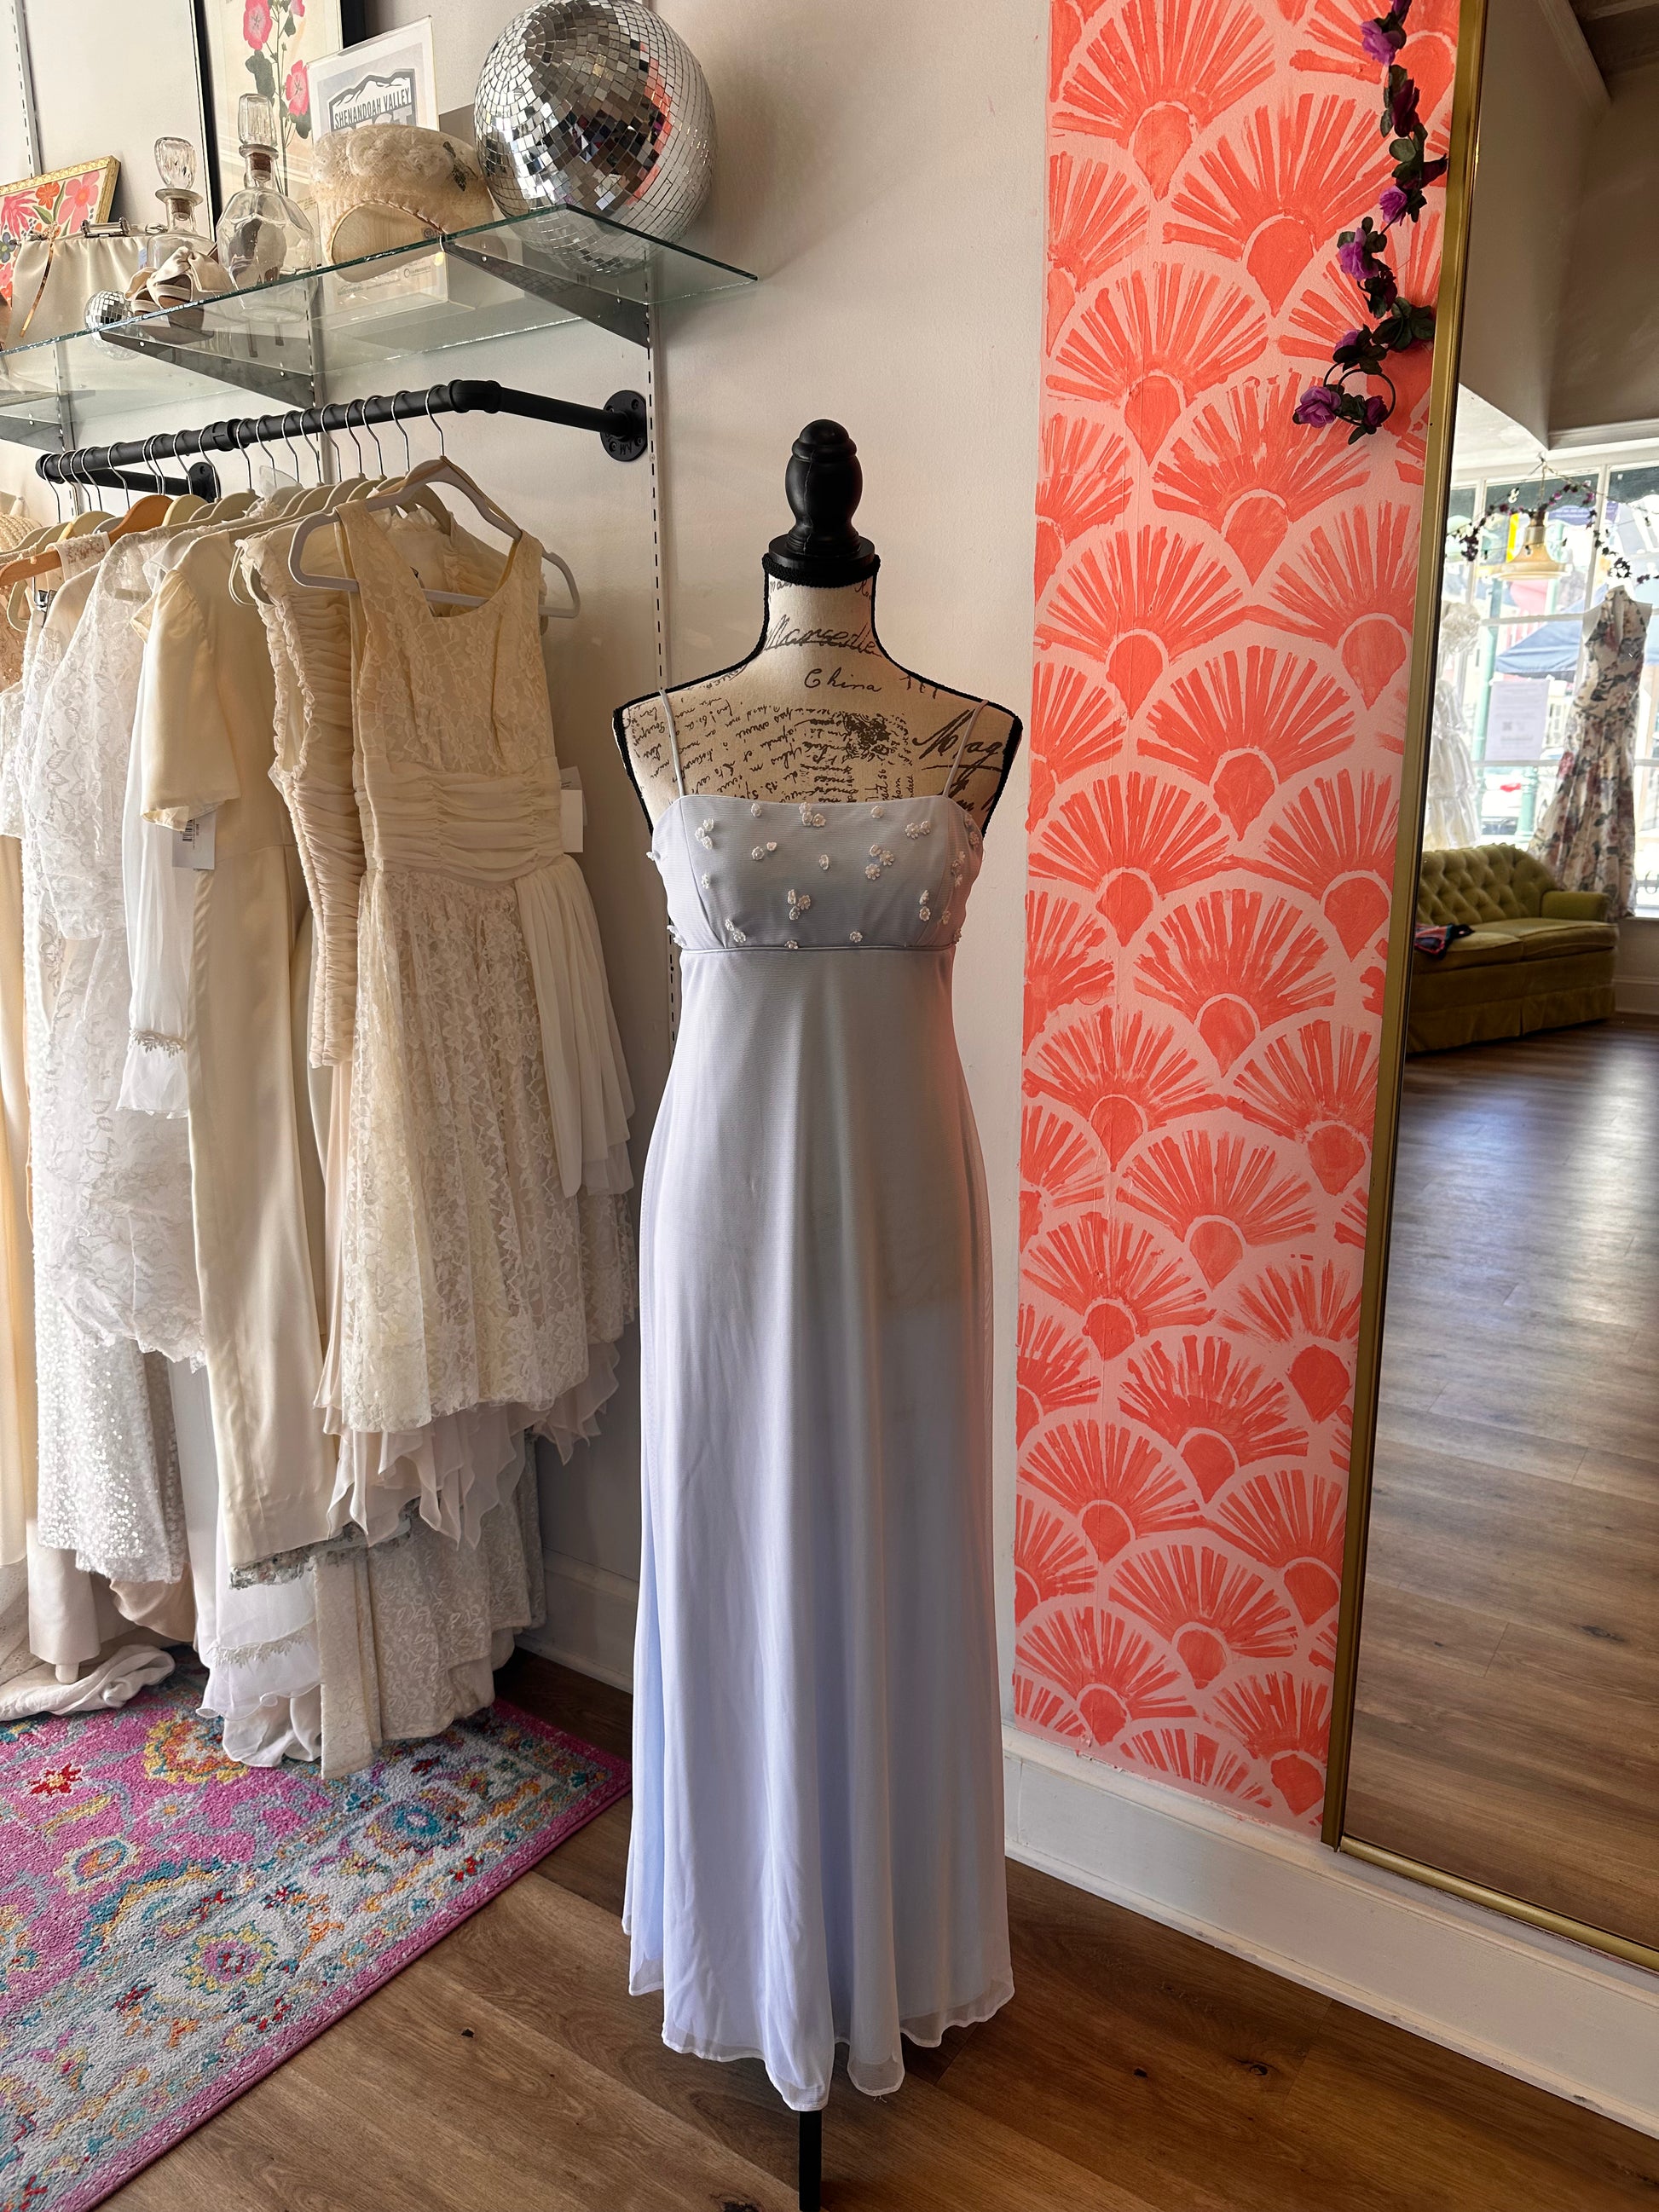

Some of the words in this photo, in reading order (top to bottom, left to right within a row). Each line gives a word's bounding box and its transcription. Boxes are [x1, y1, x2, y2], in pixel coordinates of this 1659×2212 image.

[334, 97, 382, 129] SHENANDOAH
[383, 87, 410, 112] VALLEY
[803, 667, 882, 693] China
